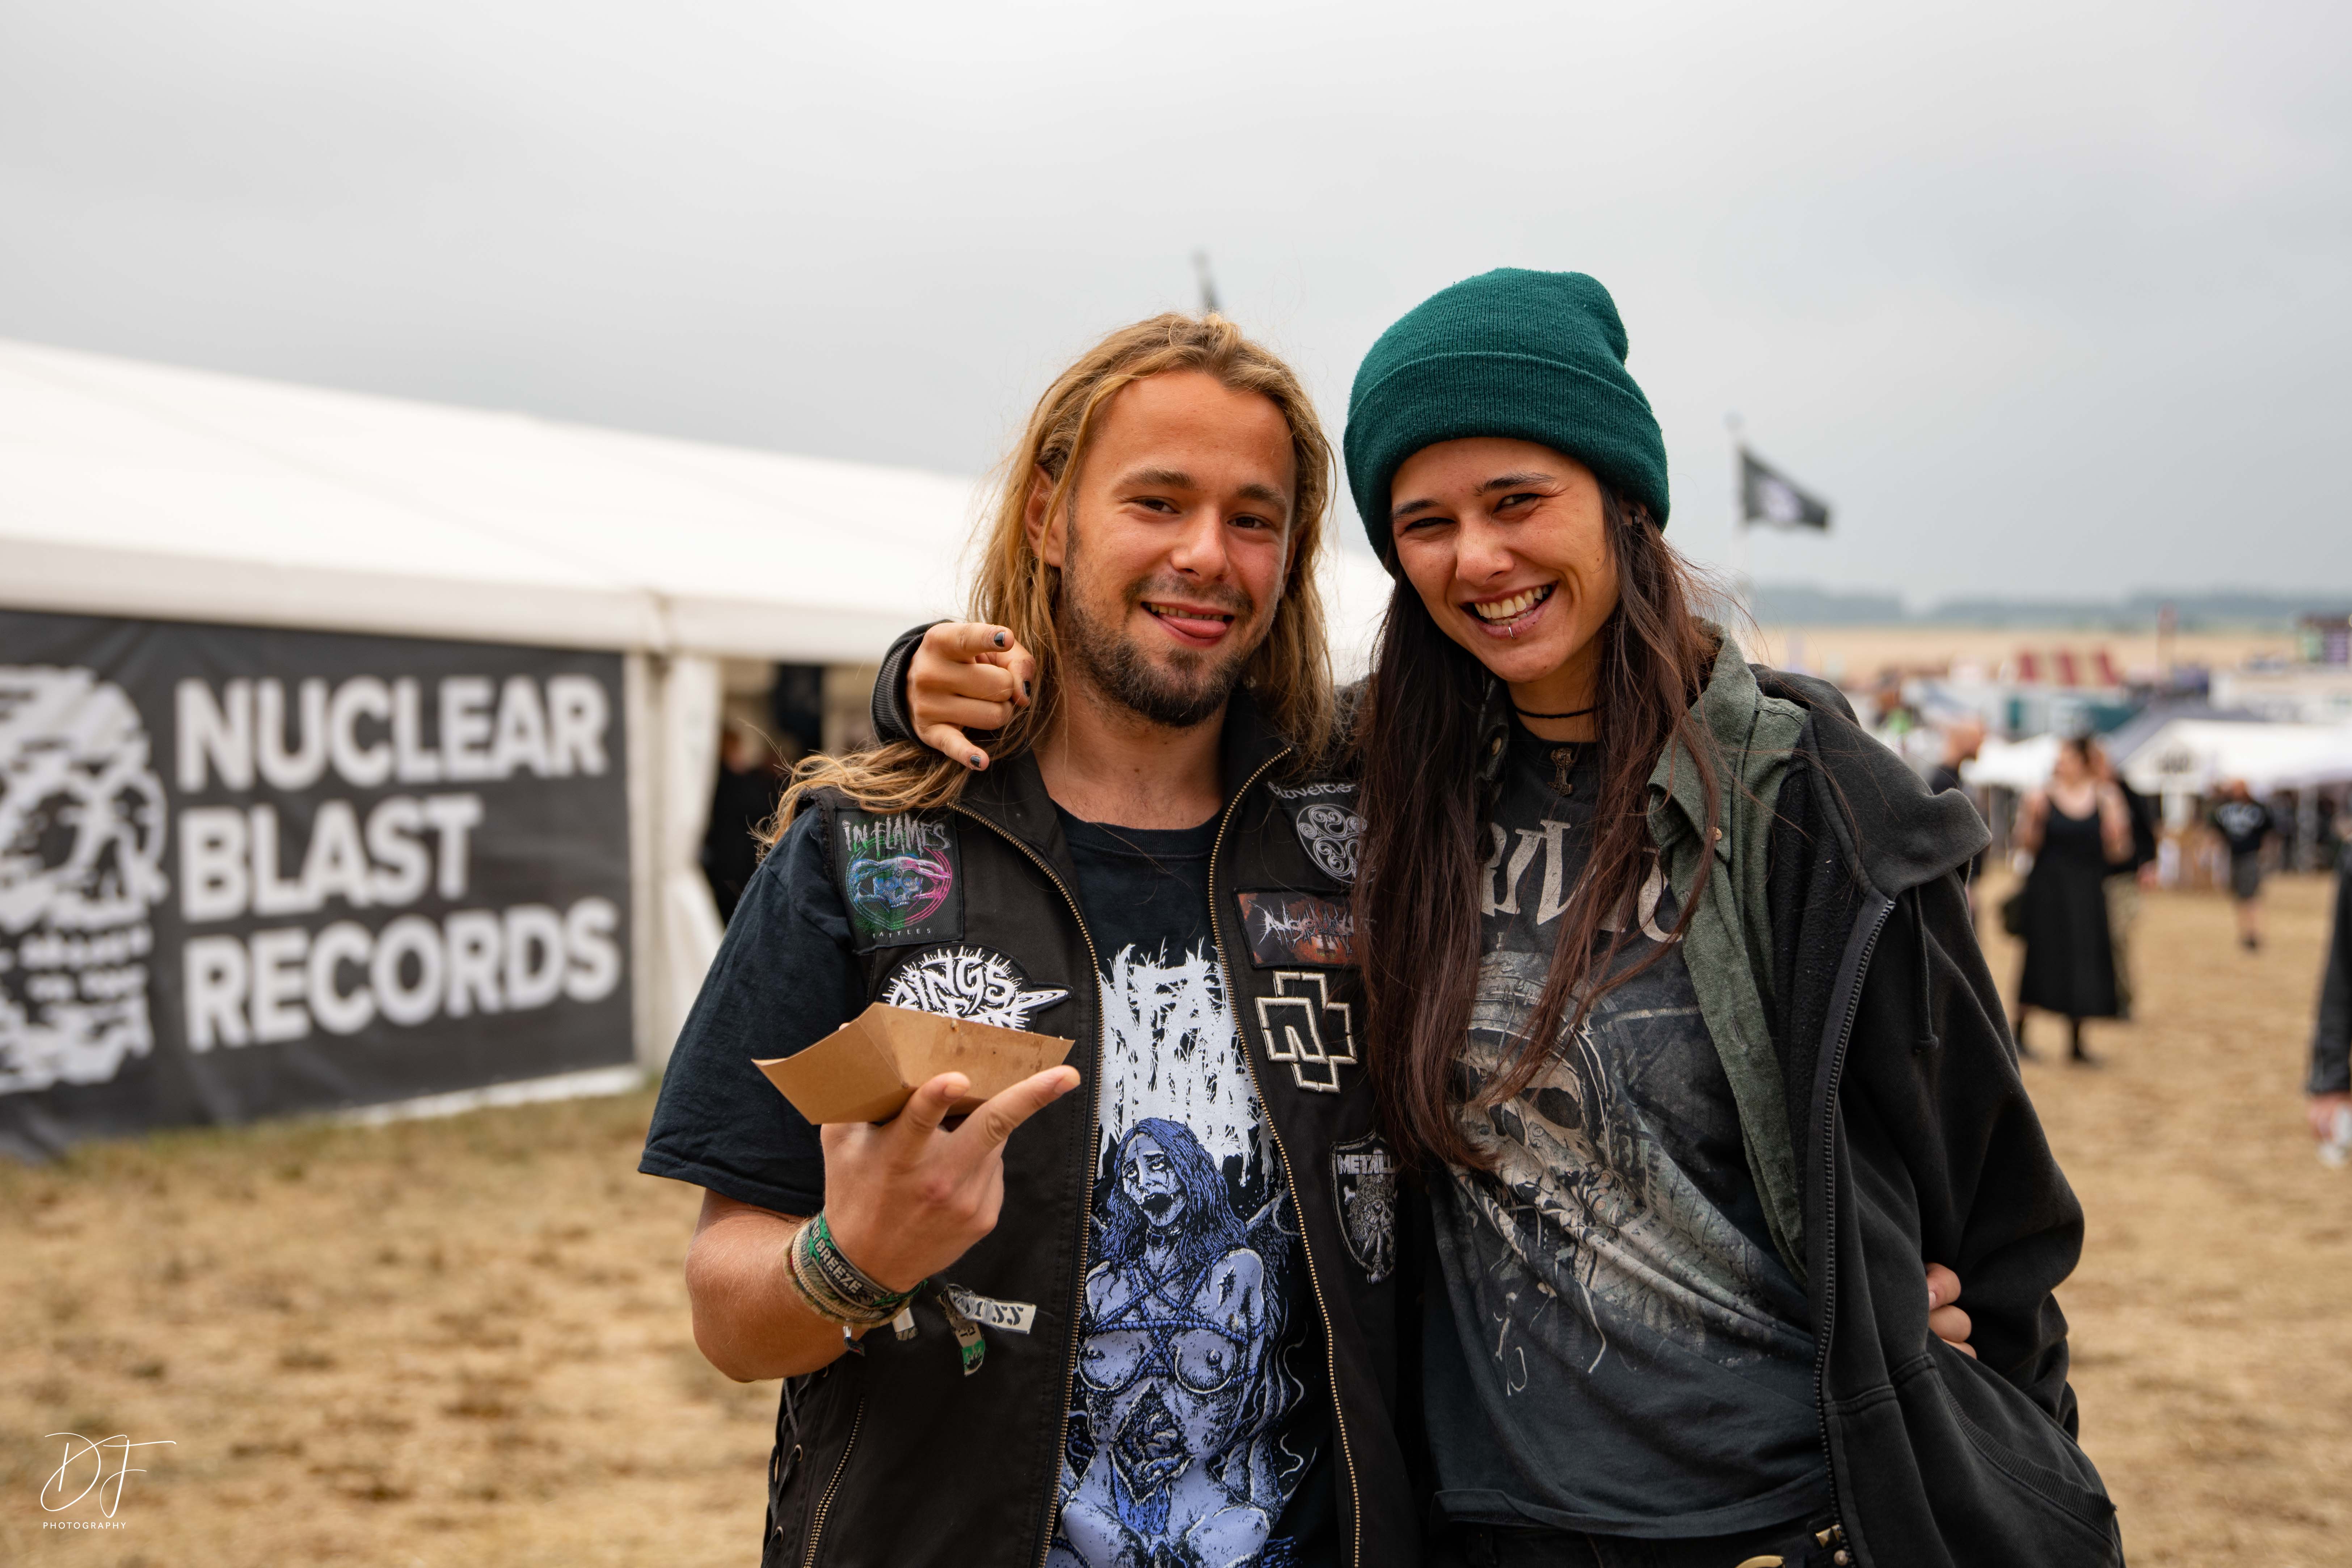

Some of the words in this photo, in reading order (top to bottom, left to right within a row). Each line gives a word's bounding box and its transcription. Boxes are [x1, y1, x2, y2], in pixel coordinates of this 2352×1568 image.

[177, 675, 608, 791] NUCLEAR
[179, 794, 482, 922] BLAST
[871, 813, 952, 859] FLAMES
[873, 928, 931, 939] ATTLES
[184, 898, 620, 1051] RECORDS
[1337, 1154, 1395, 1174] METALL
[815, 1239, 863, 1294] BREEZE
